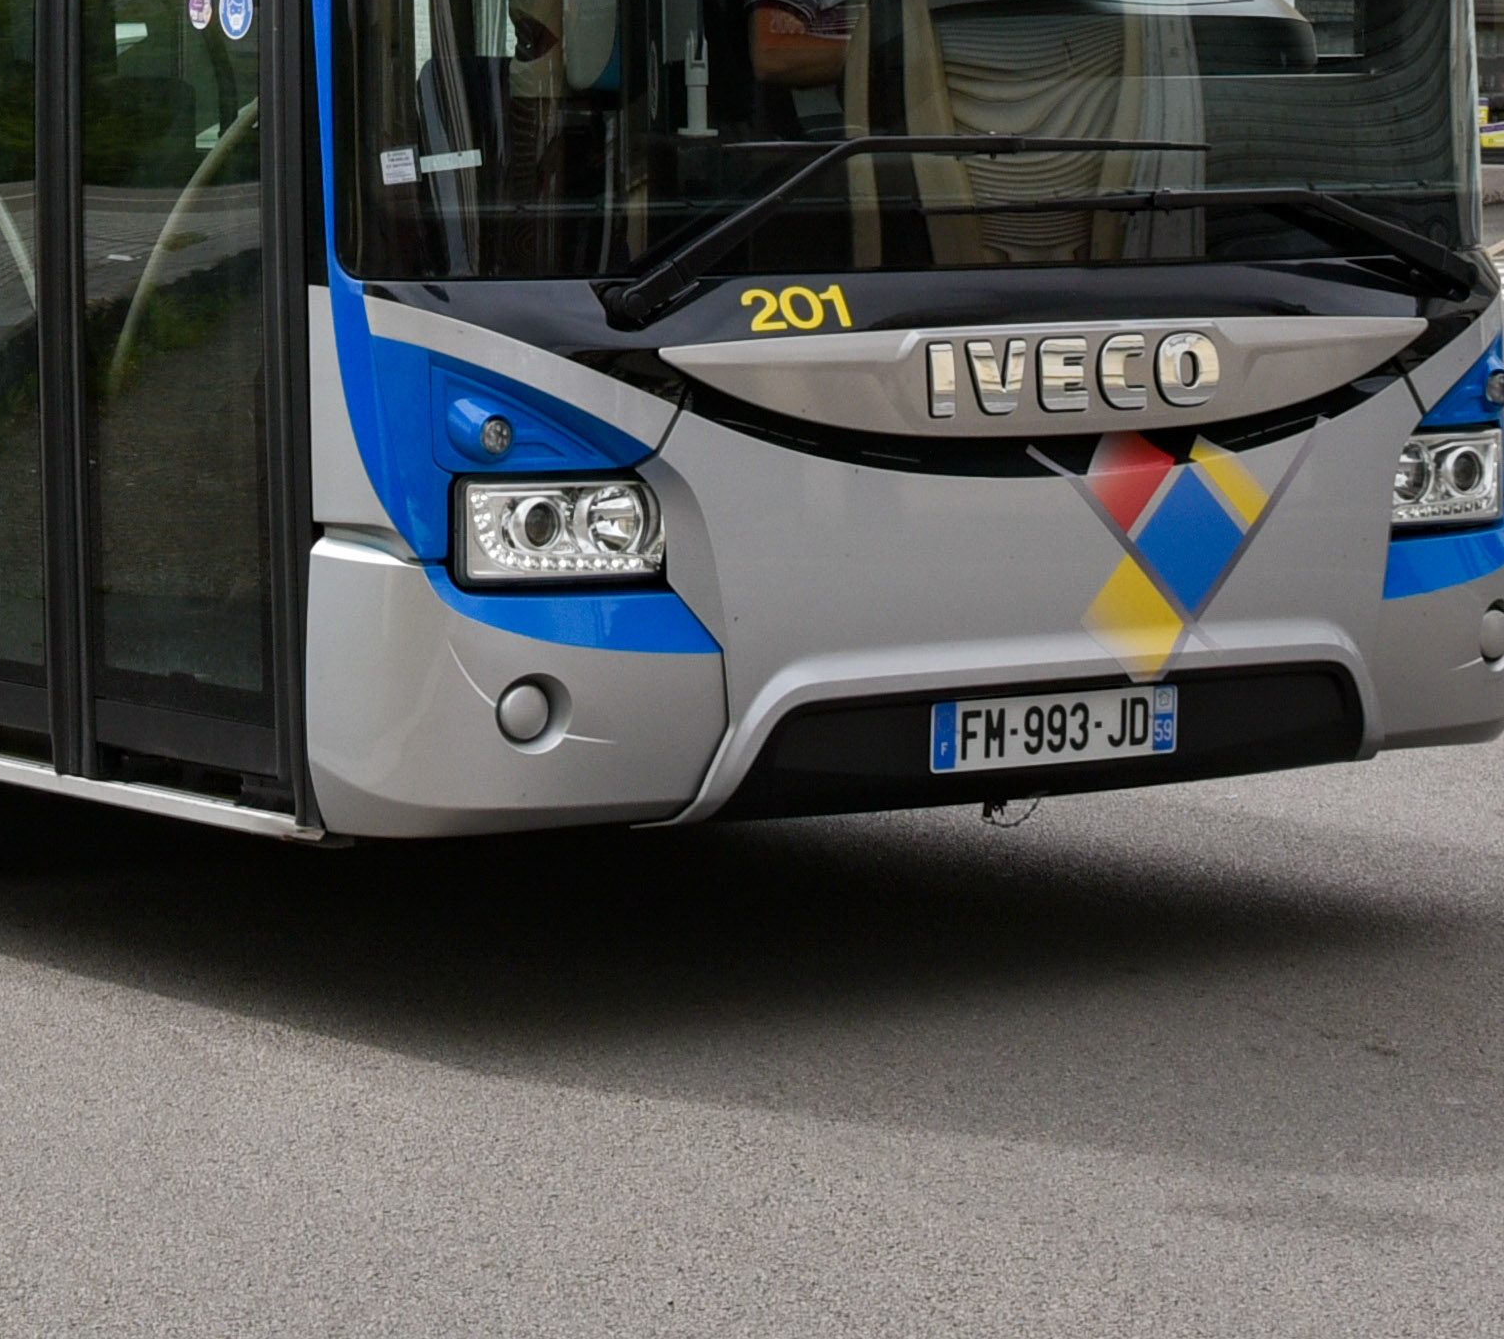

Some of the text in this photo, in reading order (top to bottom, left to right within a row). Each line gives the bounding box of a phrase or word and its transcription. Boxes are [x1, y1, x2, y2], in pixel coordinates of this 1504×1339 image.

[741, 284, 853, 332] 201
[926, 332, 1220, 419] IVECO
[941, 697, 1172, 761] F FM-993-JD 59
